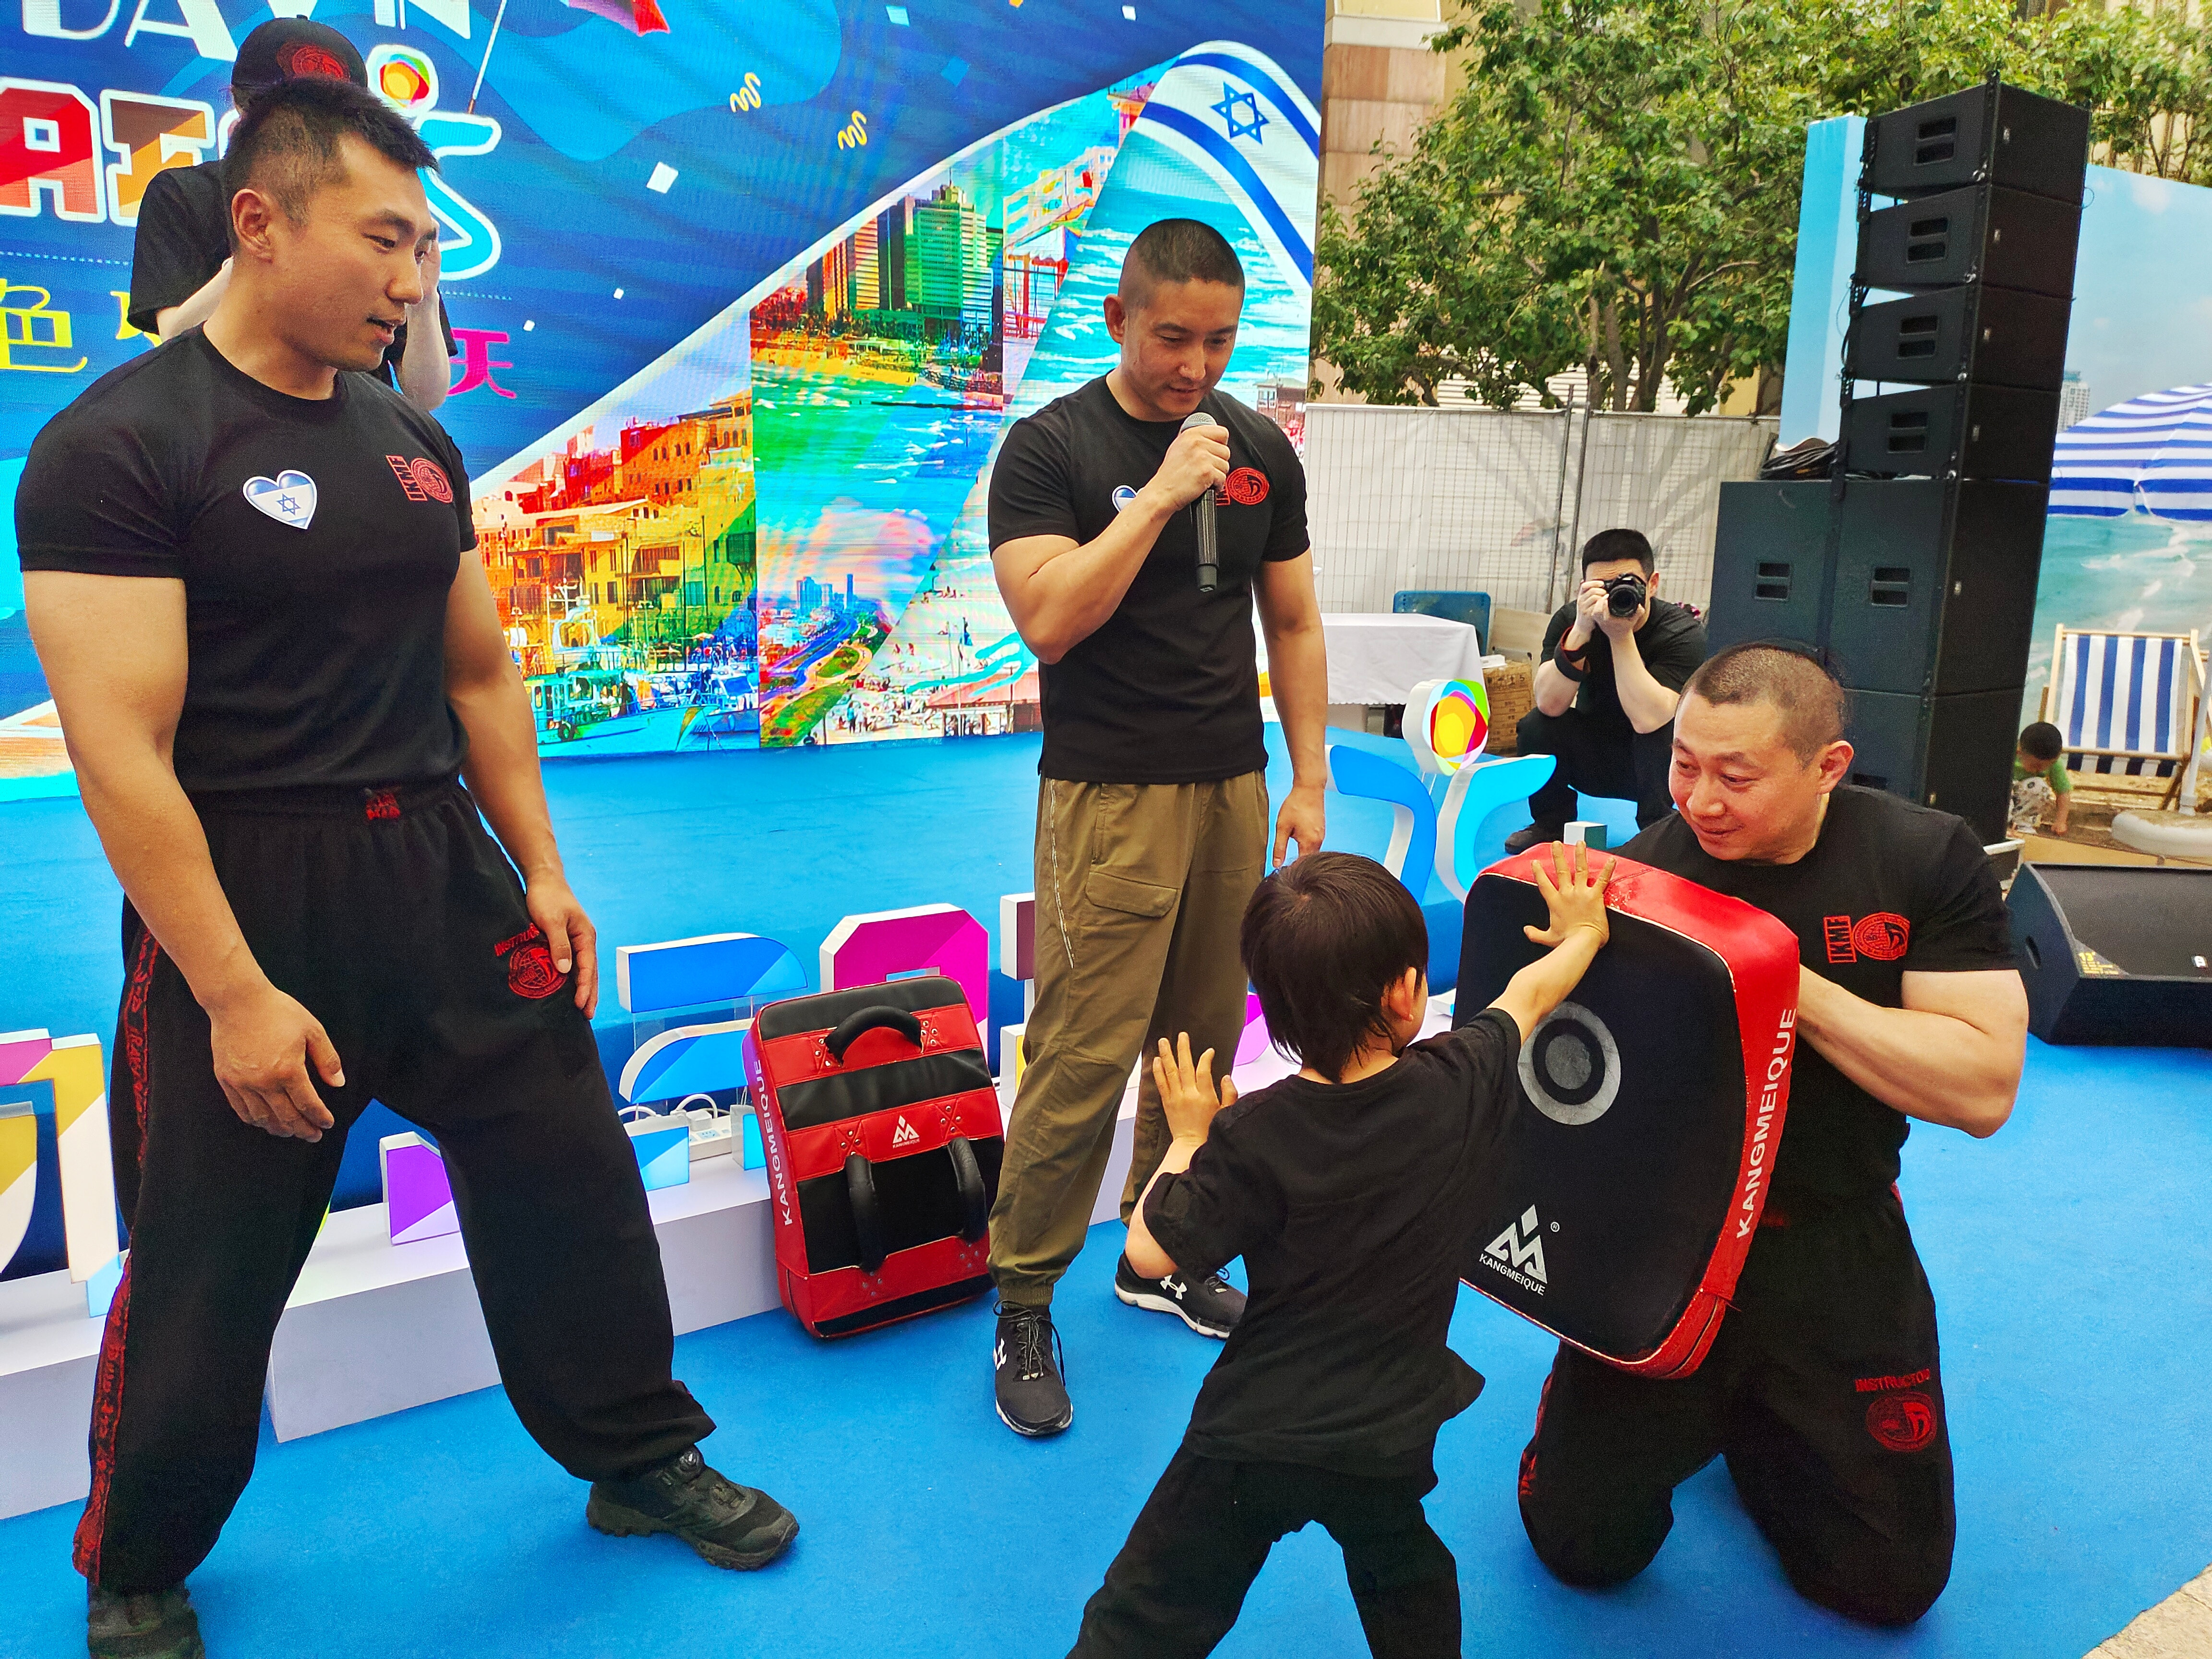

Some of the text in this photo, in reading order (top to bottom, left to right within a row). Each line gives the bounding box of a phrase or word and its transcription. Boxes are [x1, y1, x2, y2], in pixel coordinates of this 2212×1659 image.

[754, 1059, 793, 1226] KANGMEIQUE
[1736, 1008, 1796, 1238] KANGMEIQUE
[1479, 1253, 1546, 1296] KANGMEIQUE
